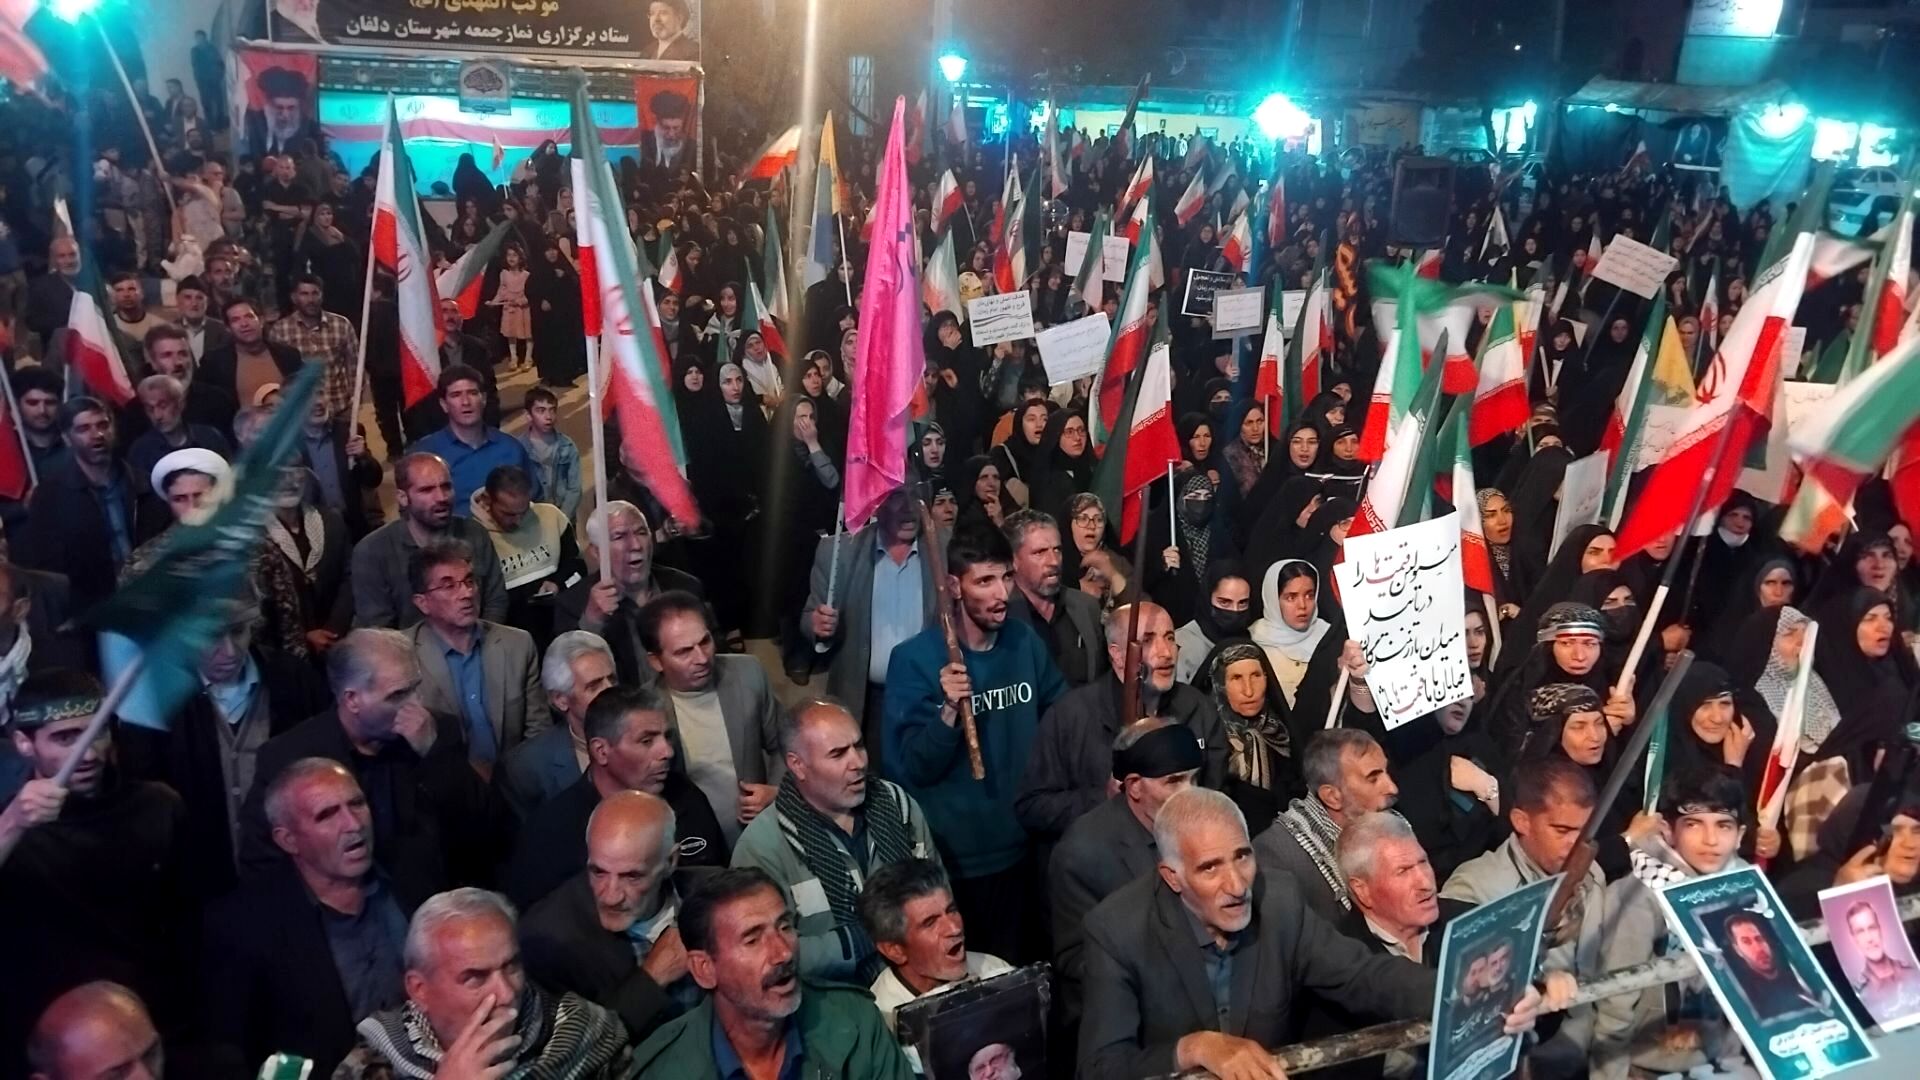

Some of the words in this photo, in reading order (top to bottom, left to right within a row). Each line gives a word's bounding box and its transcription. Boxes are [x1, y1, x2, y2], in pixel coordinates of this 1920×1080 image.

[345, 15, 390, 36] دلفان
[394, 18, 460, 41] شهرستان
[536, 23, 597, 46] برگزاری
[599, 25, 630, 44] ستاد
[1352, 560, 1365, 588] را
[1419, 622, 1460, 661] میدان
[971, 682, 1032, 716] ENTINO
